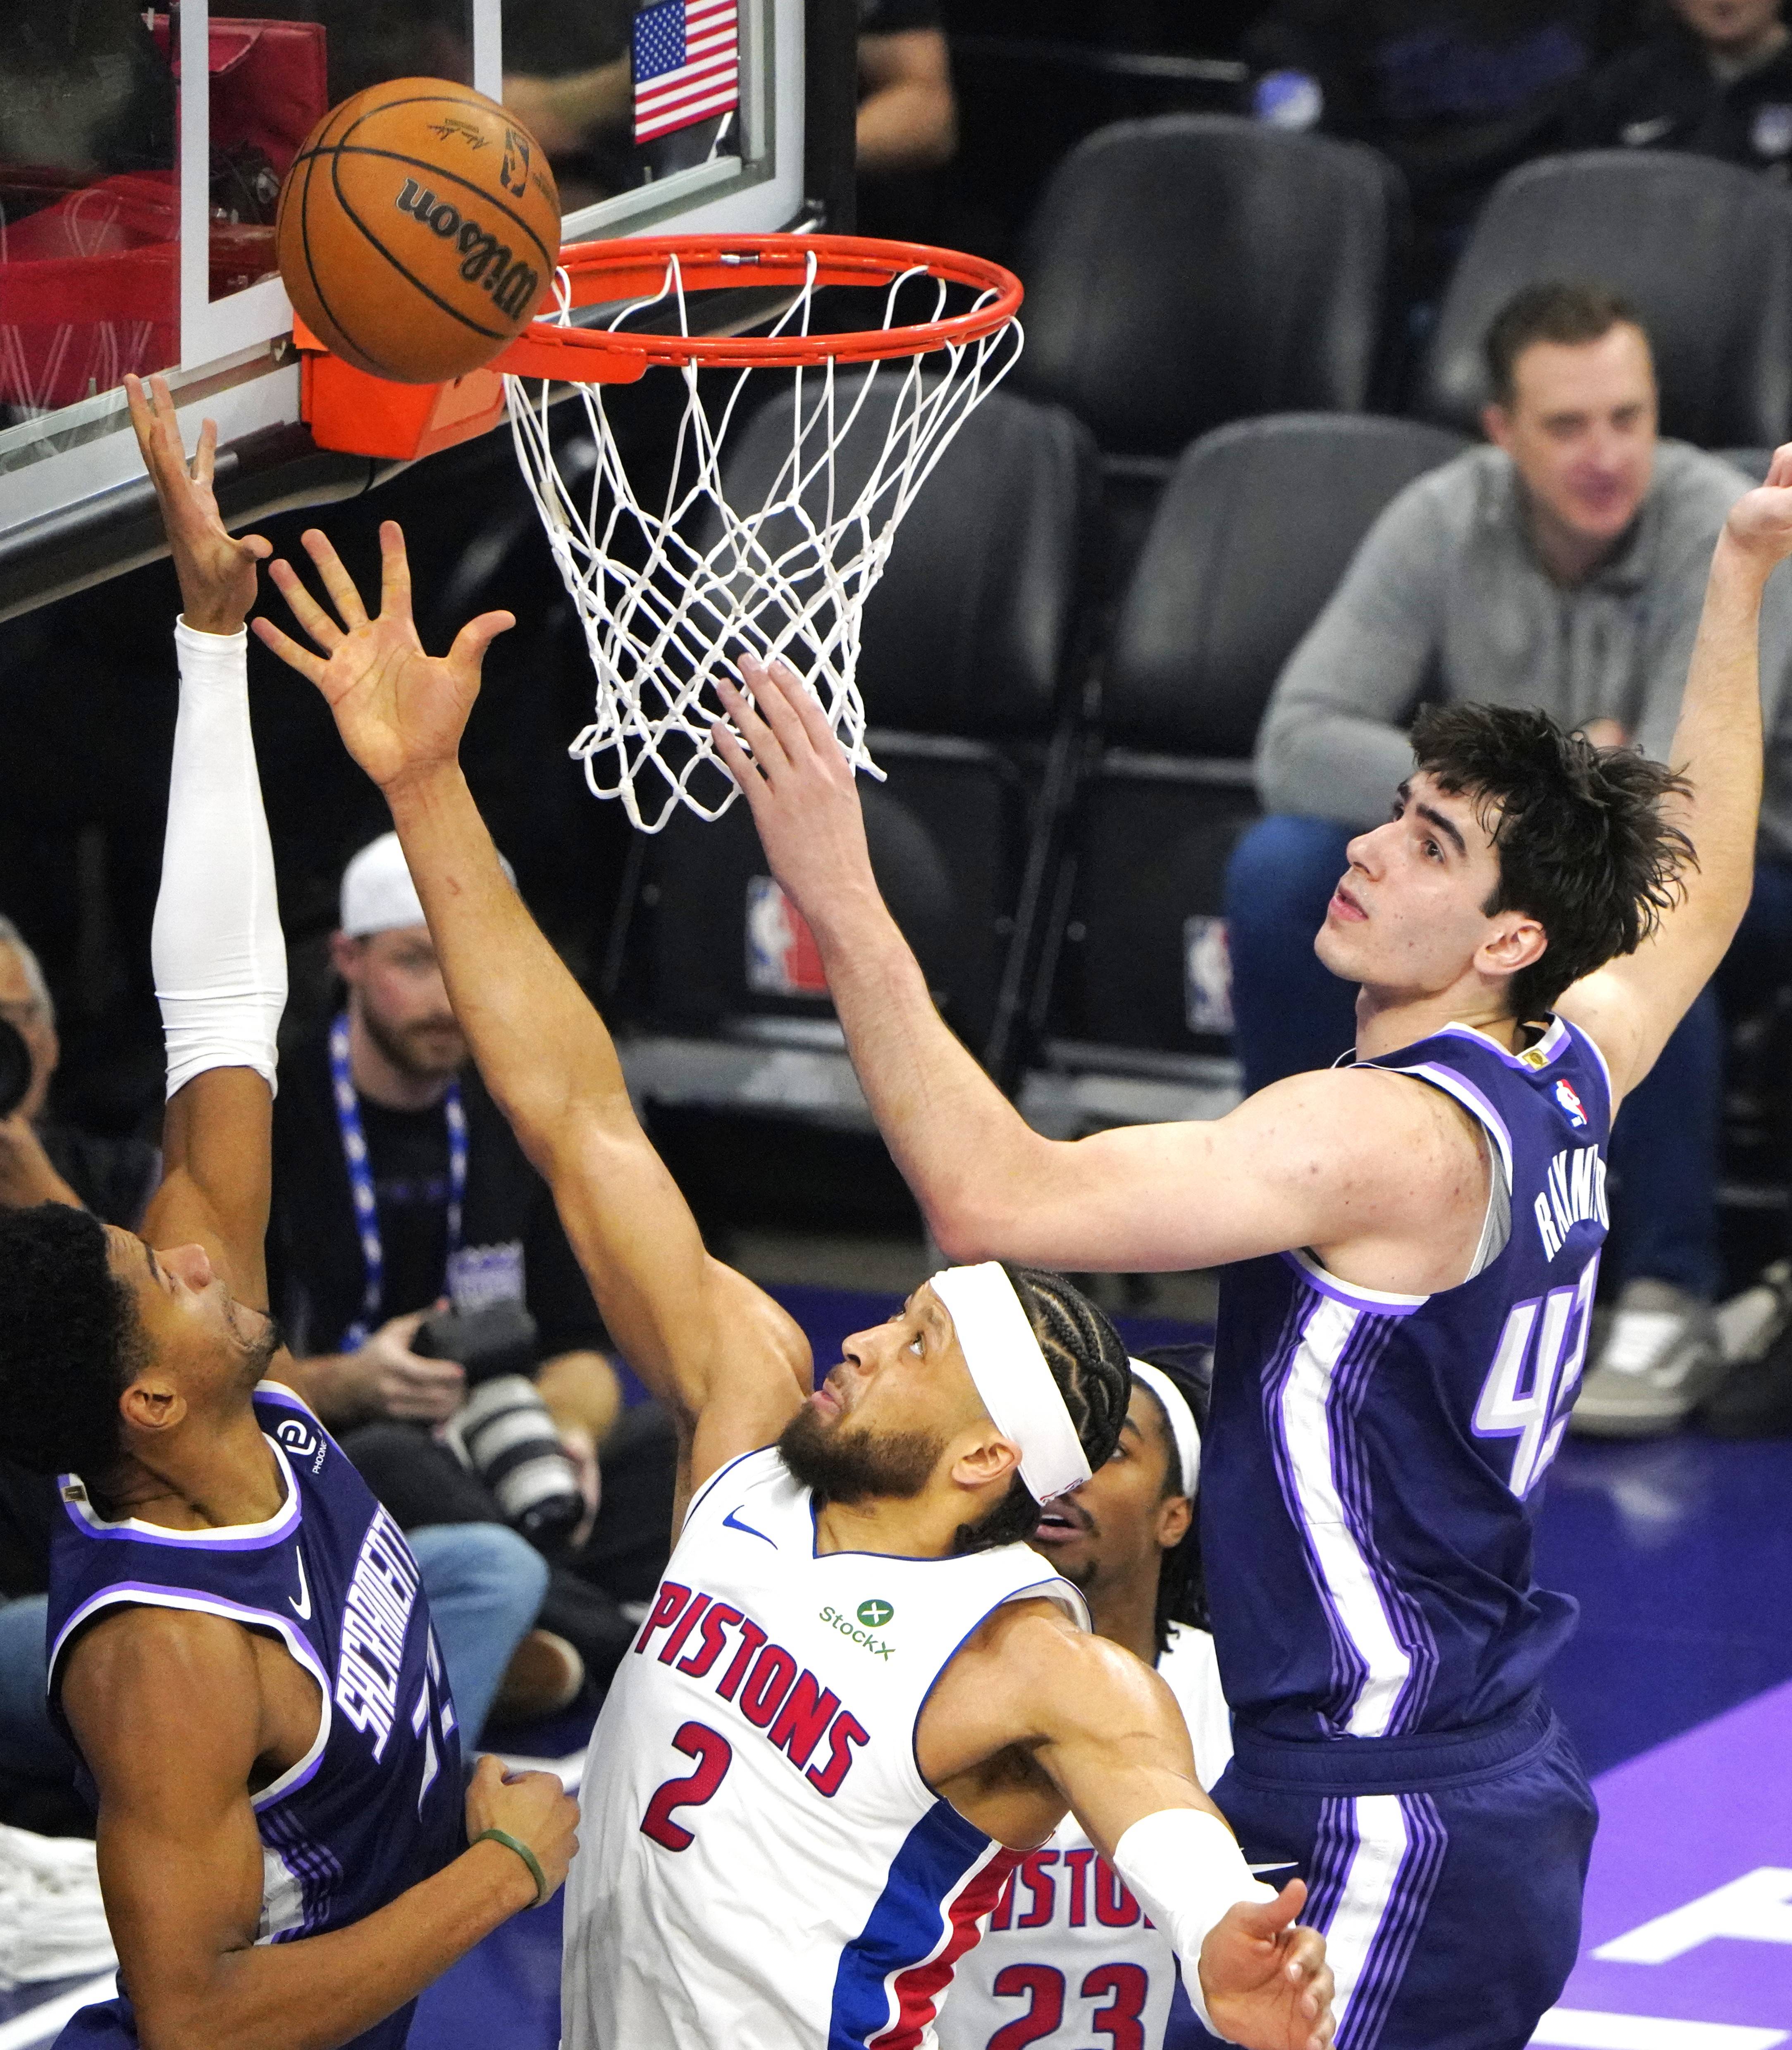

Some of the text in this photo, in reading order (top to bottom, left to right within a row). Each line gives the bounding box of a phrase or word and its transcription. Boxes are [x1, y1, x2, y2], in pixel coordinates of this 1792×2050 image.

[395, 178, 538, 321] Wilson
[635, 1580, 870, 1798] PISTONS
[820, 1606, 896, 1661] StockX
[640, 1721, 732, 1852] 2
[987, 1963, 1148, 2050] 23
